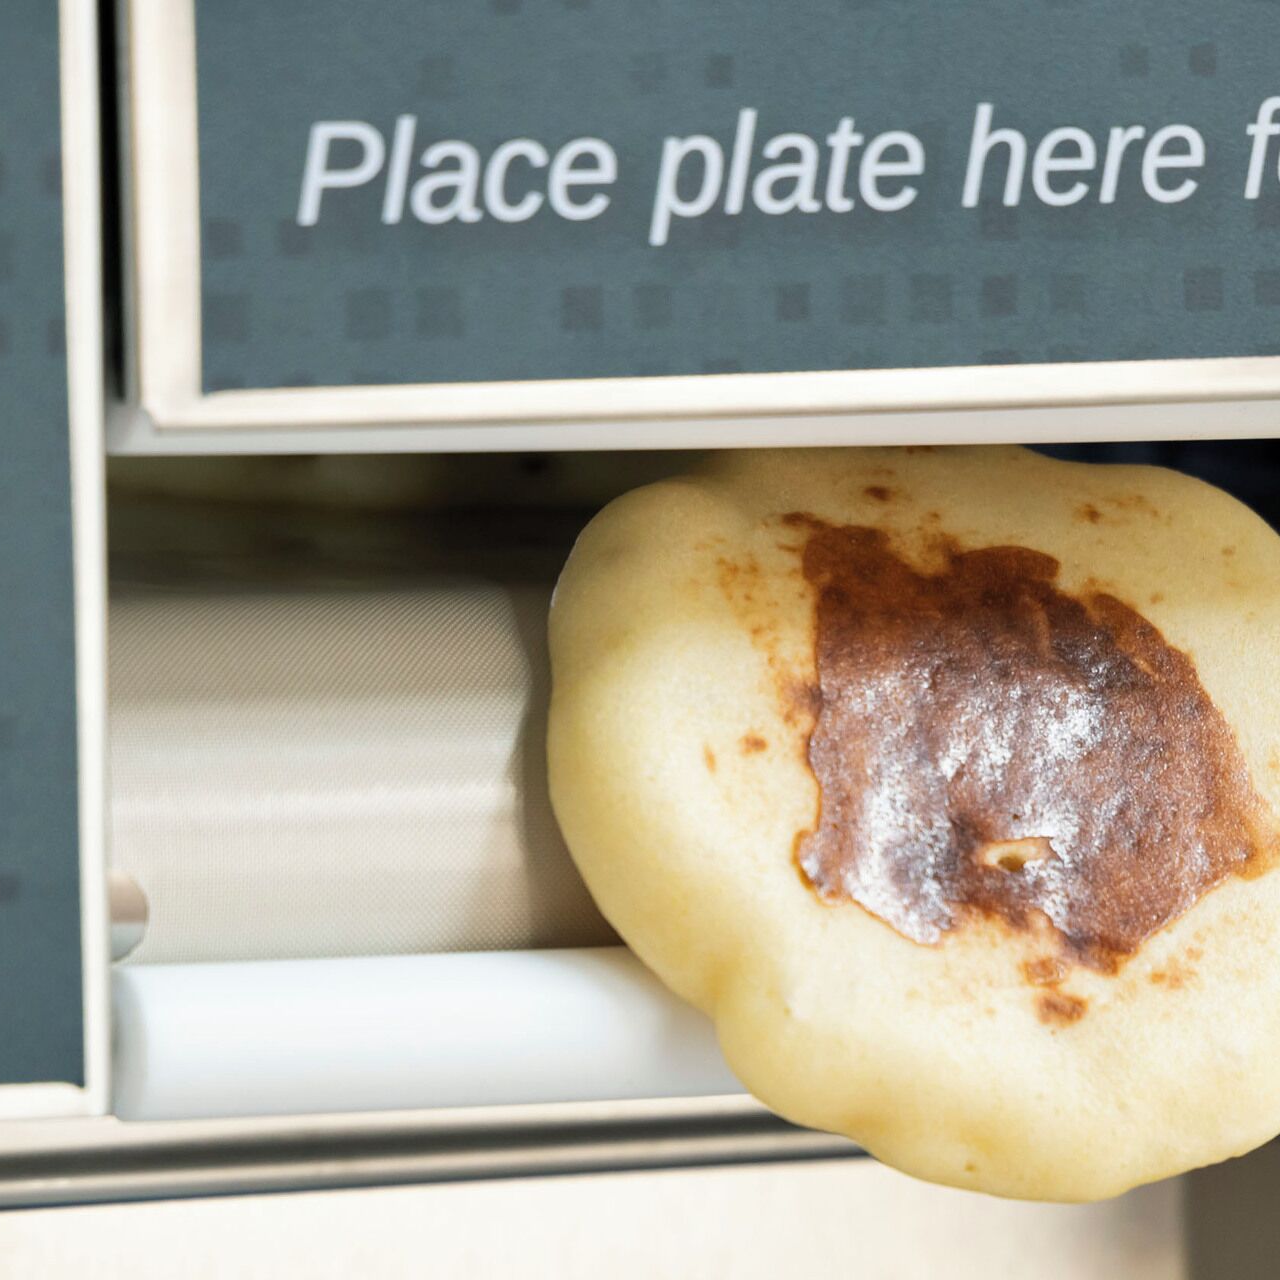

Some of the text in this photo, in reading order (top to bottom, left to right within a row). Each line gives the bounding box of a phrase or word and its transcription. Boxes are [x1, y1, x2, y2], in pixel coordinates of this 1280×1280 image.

[296, 113, 619, 227] Place
[648, 106, 926, 247] plate
[960, 101, 1207, 209] here
